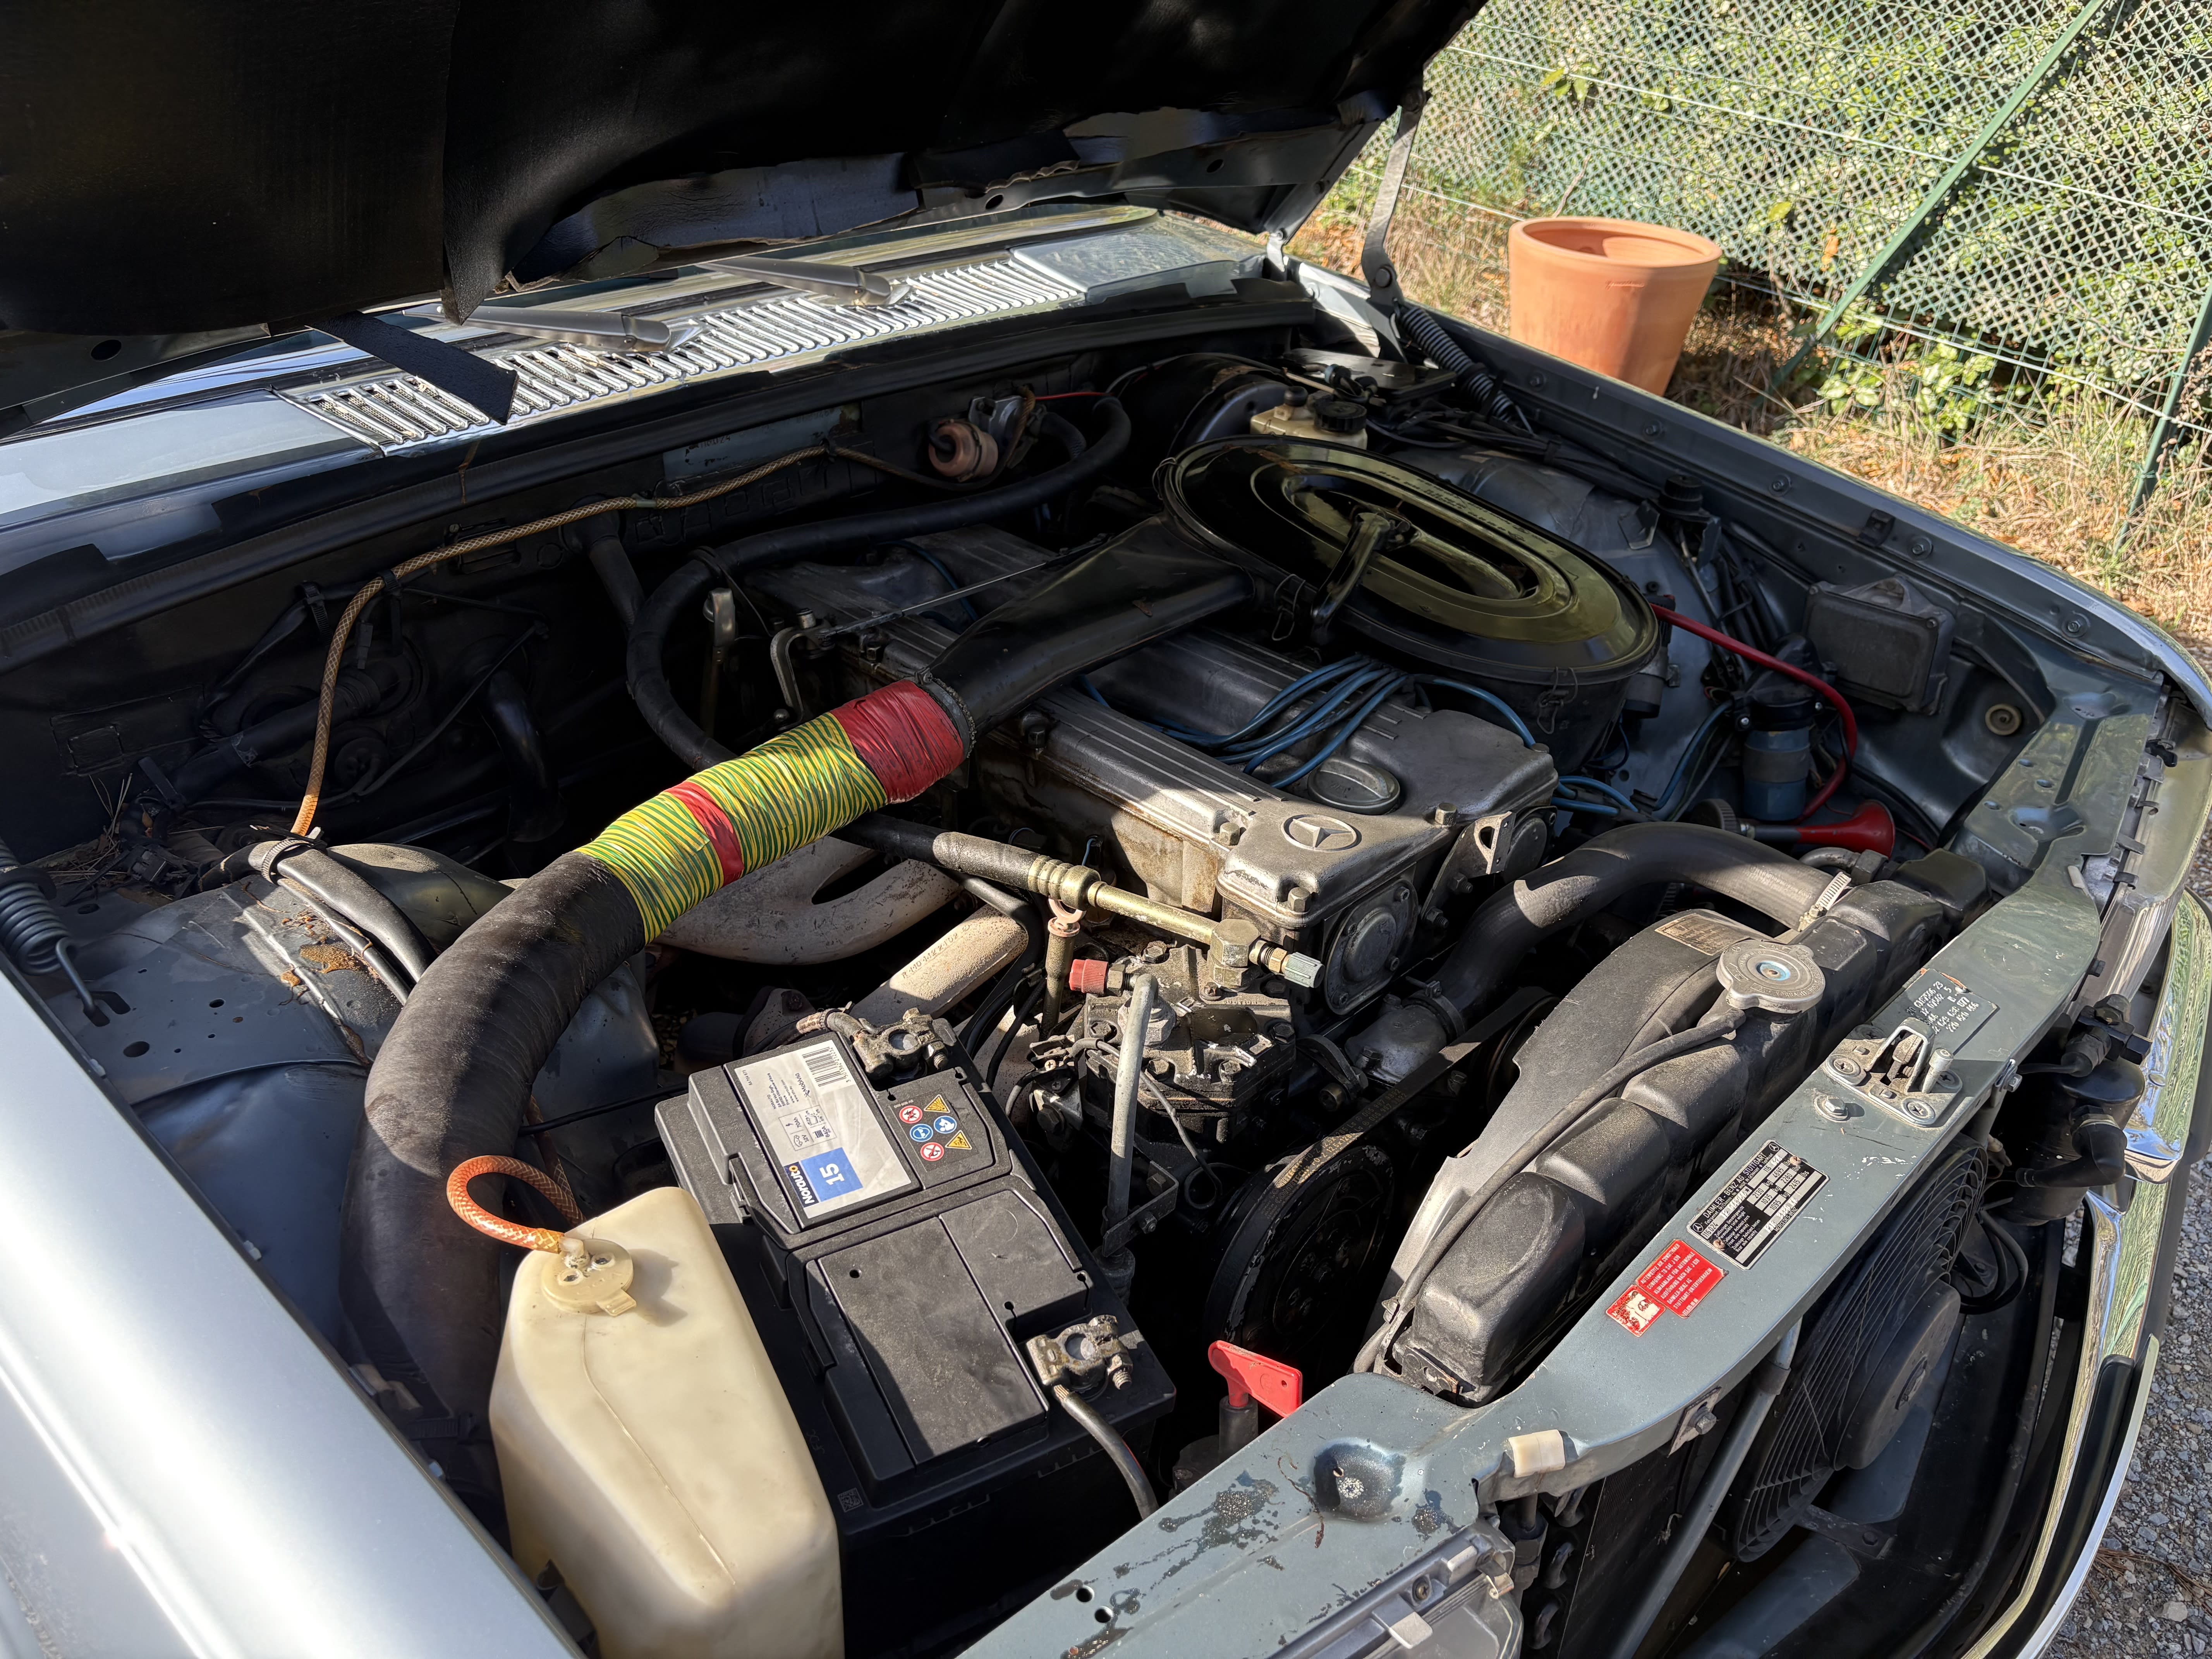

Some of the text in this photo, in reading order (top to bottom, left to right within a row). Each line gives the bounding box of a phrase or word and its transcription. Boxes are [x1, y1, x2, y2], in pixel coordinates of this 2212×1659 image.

[793, 1073, 808, 1092] Mobivia
[766, 1094, 776, 1109] NORAUTO
[792, 1116, 802, 1128] 70Ah
[821, 1125, 830, 1137] 640A
[818, 1162, 845, 1186] 15
[1780, 1172, 1793, 1184] 2280
[1800, 1169, 1810, 1177] lbs
[787, 1164, 815, 1205] Norauto
[1702, 1196, 1725, 1218] DAIMLER
[1723, 1182, 1739, 1196] BENZ
[1742, 1152, 1767, 1176] STUTTGART
[1788, 1178, 1801, 1189] 2415
[1752, 1187, 1764, 1199] 2130
[1760, 1193, 1773, 1205] 1035
[1769, 1199, 1782, 1211] 1095
[1639, 1265, 1659, 1285] AUTOMOTIVE
[1653, 1273, 1674, 1295] KLIMAANLAGE
[1676, 1251, 1695, 1270] AUTOMOBILE
[1646, 1273, 1664, 1290] CONFORMS
